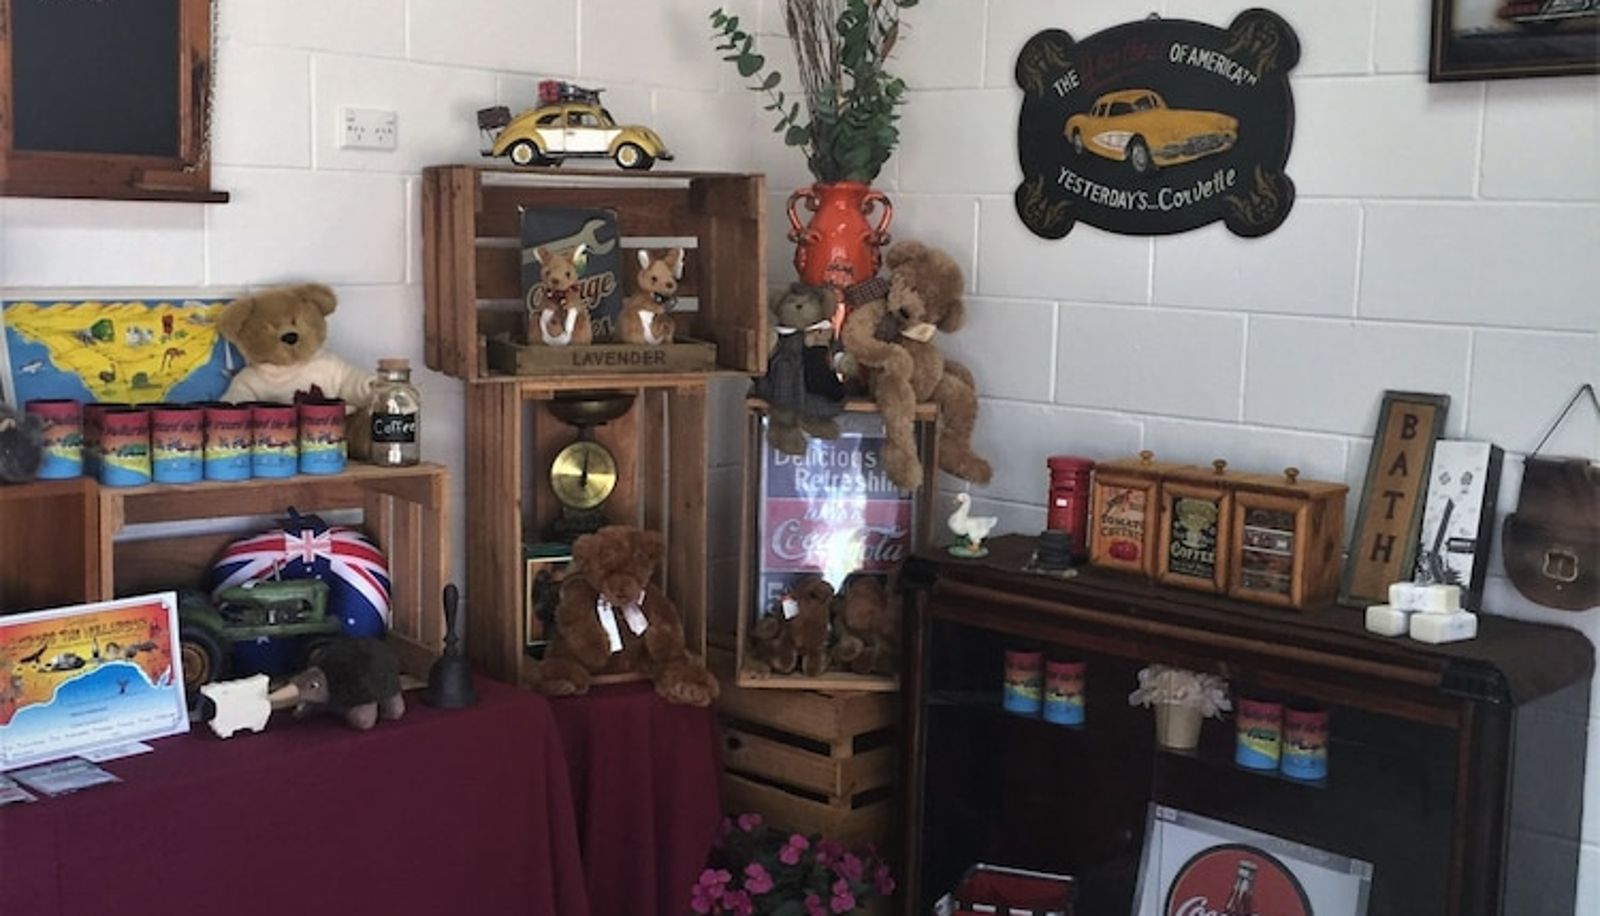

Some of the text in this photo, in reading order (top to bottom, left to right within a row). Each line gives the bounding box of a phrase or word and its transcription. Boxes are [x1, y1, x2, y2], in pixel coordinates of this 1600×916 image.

[1051, 68, 1081, 98] THE
[1168, 42, 1187, 64] OF
[571, 351, 666, 367] LAVENDER
[373, 419, 416, 436] Coffee
[794, 467, 899, 493] Refreshi
[1370, 413, 1419, 564] BATH
